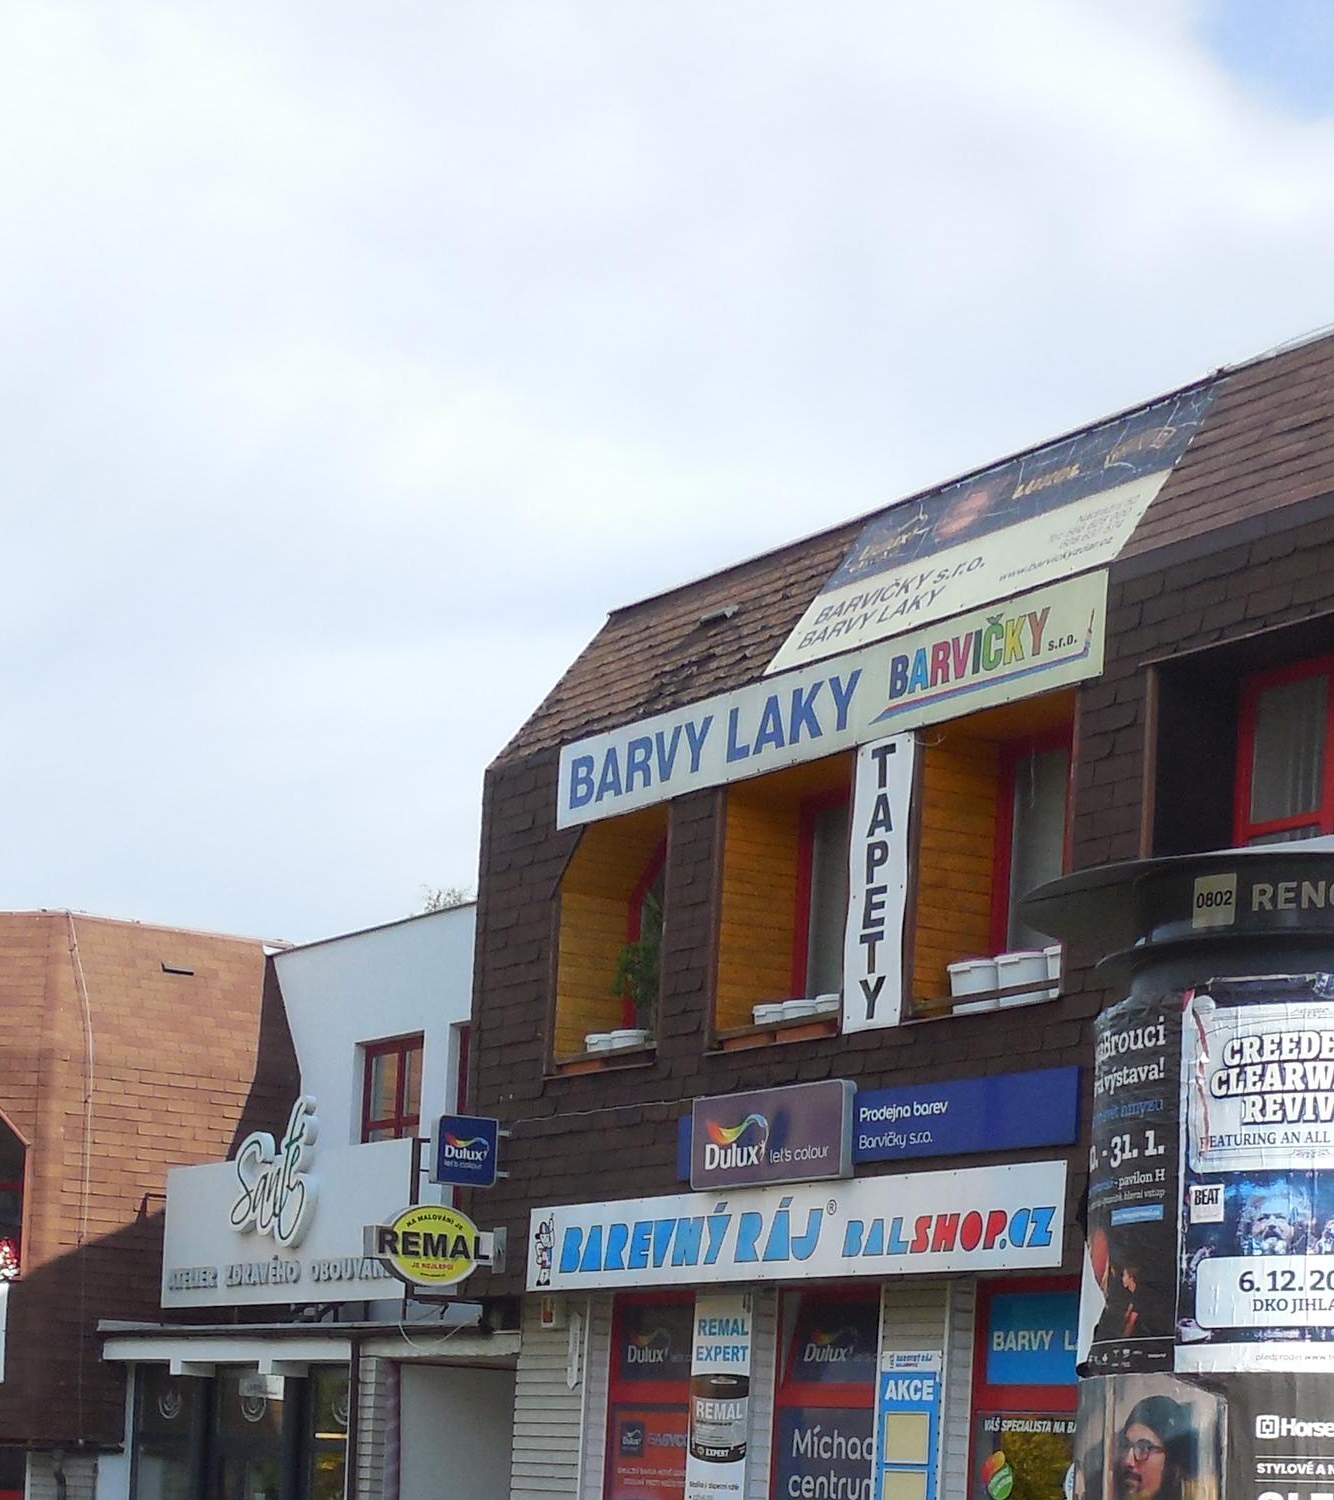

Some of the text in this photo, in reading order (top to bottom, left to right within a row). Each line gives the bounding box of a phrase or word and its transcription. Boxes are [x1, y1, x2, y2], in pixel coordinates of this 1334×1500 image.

[816, 555, 985, 624] BARVIČKY s.r.o.
[797, 585, 946, 651] BARVY LAKY
[889, 606, 1078, 699] BARVIČKY s.r.o.
[569, 669, 863, 811] BARVY LAKY
[859, 742, 897, 1021] TAPETY
[1196, 889, 1233, 909] 0802
[859, 1100, 949, 1123] Prodejna barev
[858, 1130, 907, 1150] Barvičky
[1144, 1130, 1165, 1158] 1.
[1200, 1132, 1279, 1148] FEATURING
[1281, 1131, 1301, 1144] AN
[1303, 1131, 1330, 1145] ALL
[444, 1144, 483, 1161] Dulux
[704, 1143, 830, 1171] Dulux let's colour
[1194, 1189, 1220, 1206] BEAT
[378, 1229, 490, 1261] REMAL
[558, 1196, 1057, 1275] BAREVNÝ RÁJ BALSHOP.CZ
[226, 1255, 302, 1288] ZDRAVÉHO
[1239, 1270, 1261, 1292] 6.
[1267, 1270, 1304, 1292] 12.
[1252, 1298, 1288, 1312] DKO
[698, 1318, 749, 1337] REMAL
[992, 1330, 1053, 1351] BARVY
[627, 1344, 664, 1364] Dulux
[696, 1345, 749, 1362] EXPERT
[803, 1343, 848, 1363] Dulux
[885, 1379, 934, 1401] AKCE
[696, 1400, 744, 1420] REMAL
[984, 1418, 1066, 1434] VÁŠ SPECIALISTA NA
[1256, 1461, 1313, 1475] STYLOVÉ
[1315, 1464, 1327, 1475] A
